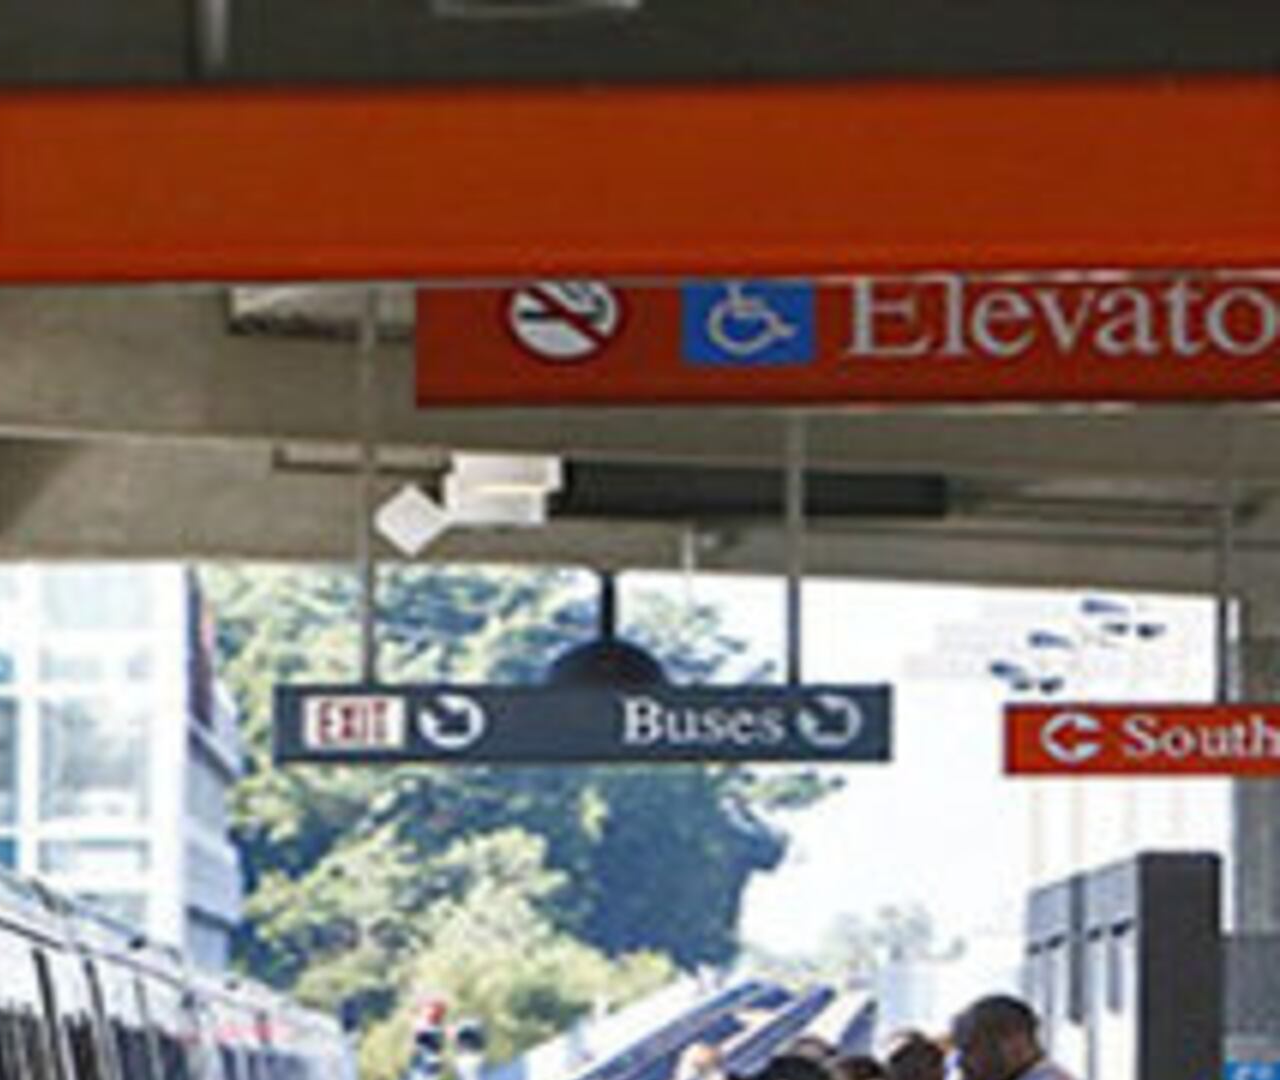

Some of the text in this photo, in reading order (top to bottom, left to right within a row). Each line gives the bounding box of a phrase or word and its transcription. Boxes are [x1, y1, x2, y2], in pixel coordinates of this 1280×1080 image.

[844, 275, 1278, 356] Elevato
[315, 699, 389, 743] EXIT
[620, 697, 786, 745] Buses
[1122, 713, 1280, 758] South
